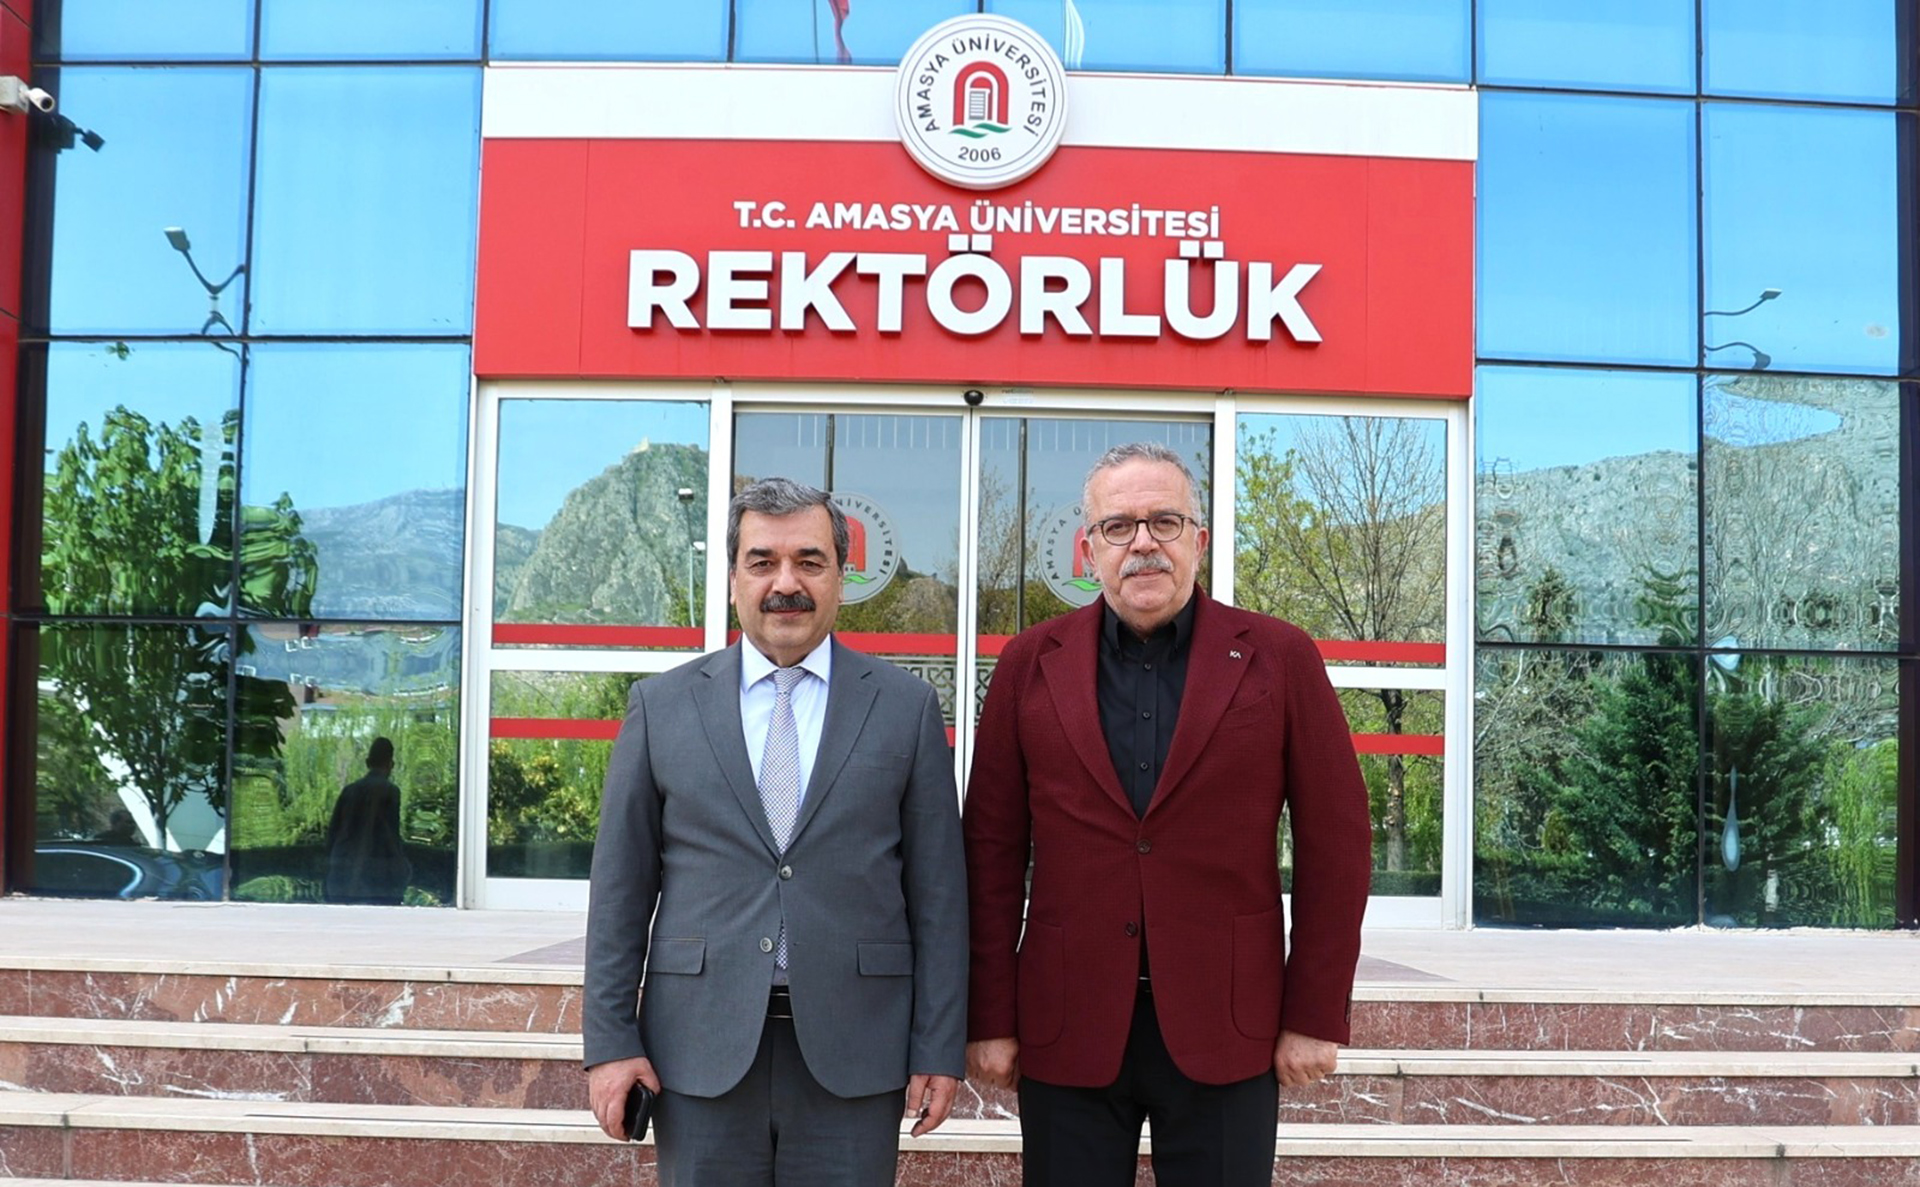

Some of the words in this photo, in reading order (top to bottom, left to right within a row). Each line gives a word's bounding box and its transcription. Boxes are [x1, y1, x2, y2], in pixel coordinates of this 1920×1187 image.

[916, 53, 950, 132] AMASYA
[952, 33, 1047, 137] ÜNİVERSİTESİ
[958, 146, 1001, 162] 2006
[733, 201, 795, 229] T.C.
[805, 203, 957, 232] AMASYA
[971, 200, 1219, 238] ÜNİVERSİTESİ
[627, 233, 1322, 342] REKTÖRLÜK
[1046, 519, 1067, 580] AMASYA
